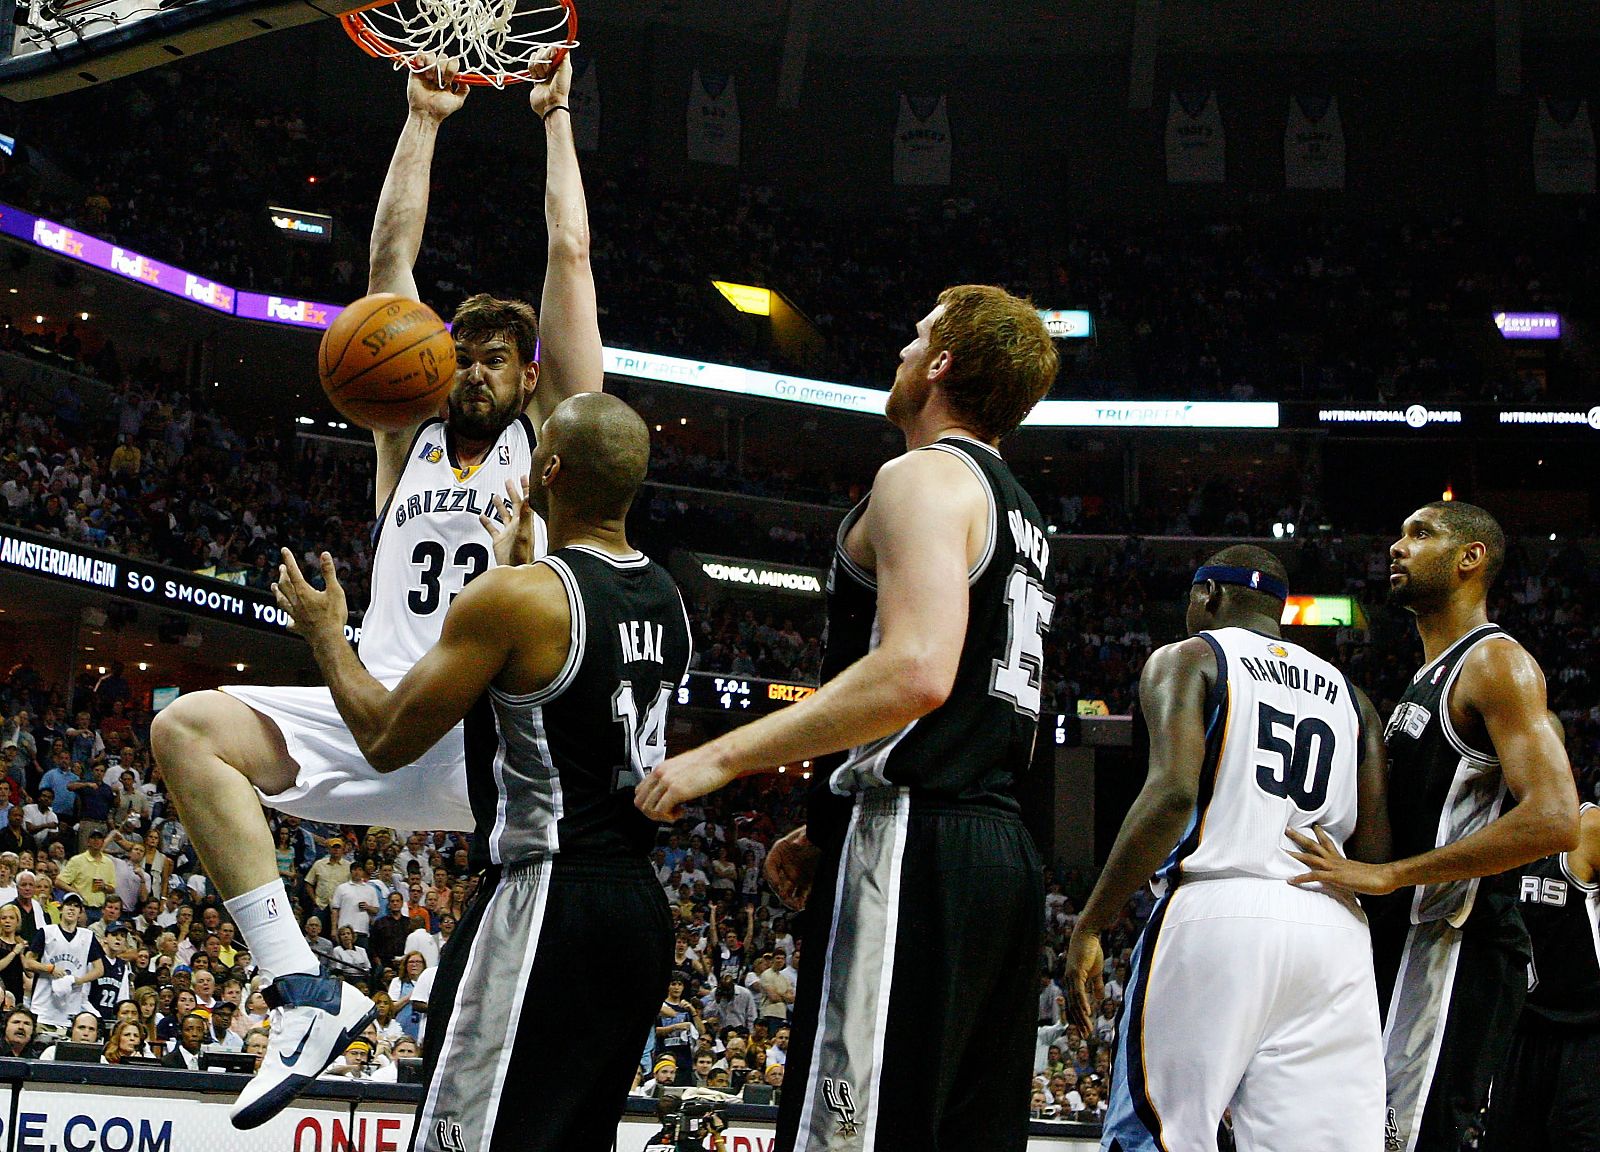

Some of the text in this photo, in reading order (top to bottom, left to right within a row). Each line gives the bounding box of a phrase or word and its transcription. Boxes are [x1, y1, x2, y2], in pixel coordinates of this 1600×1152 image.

[33, 220, 84, 258] FedEx
[111, 247, 160, 284] FedEx
[185, 274, 231, 310] FedEx
[267, 296, 327, 325] FedEx
[614, 356, 698, 378] TRUGREEN
[774, 380, 796, 395] Go
[1095, 408, 1185, 422] TRUGREEN
[1319, 410, 1462, 423] INTERNATIONAL PAPER
[1499, 412, 1589, 424] INTERNATIONAL
[127, 572, 155, 593] SO
[165, 581, 244, 615] SMOOTH
[408, 541, 489, 616] 33
[702, 564, 820, 592] KONICA MINOLTA
[618, 620, 664, 665] NEAL
[988, 564, 1056, 723] 15
[1240, 657, 1339, 705] RANDOLPH
[720, 692, 732, 709] 4
[611, 680, 675, 791] 14
[1055, 727, 1066, 744] 5
[1255, 701, 1336, 812] 50
[1520, 875, 1568, 907] RS
[100, 989, 117, 1008] 22
